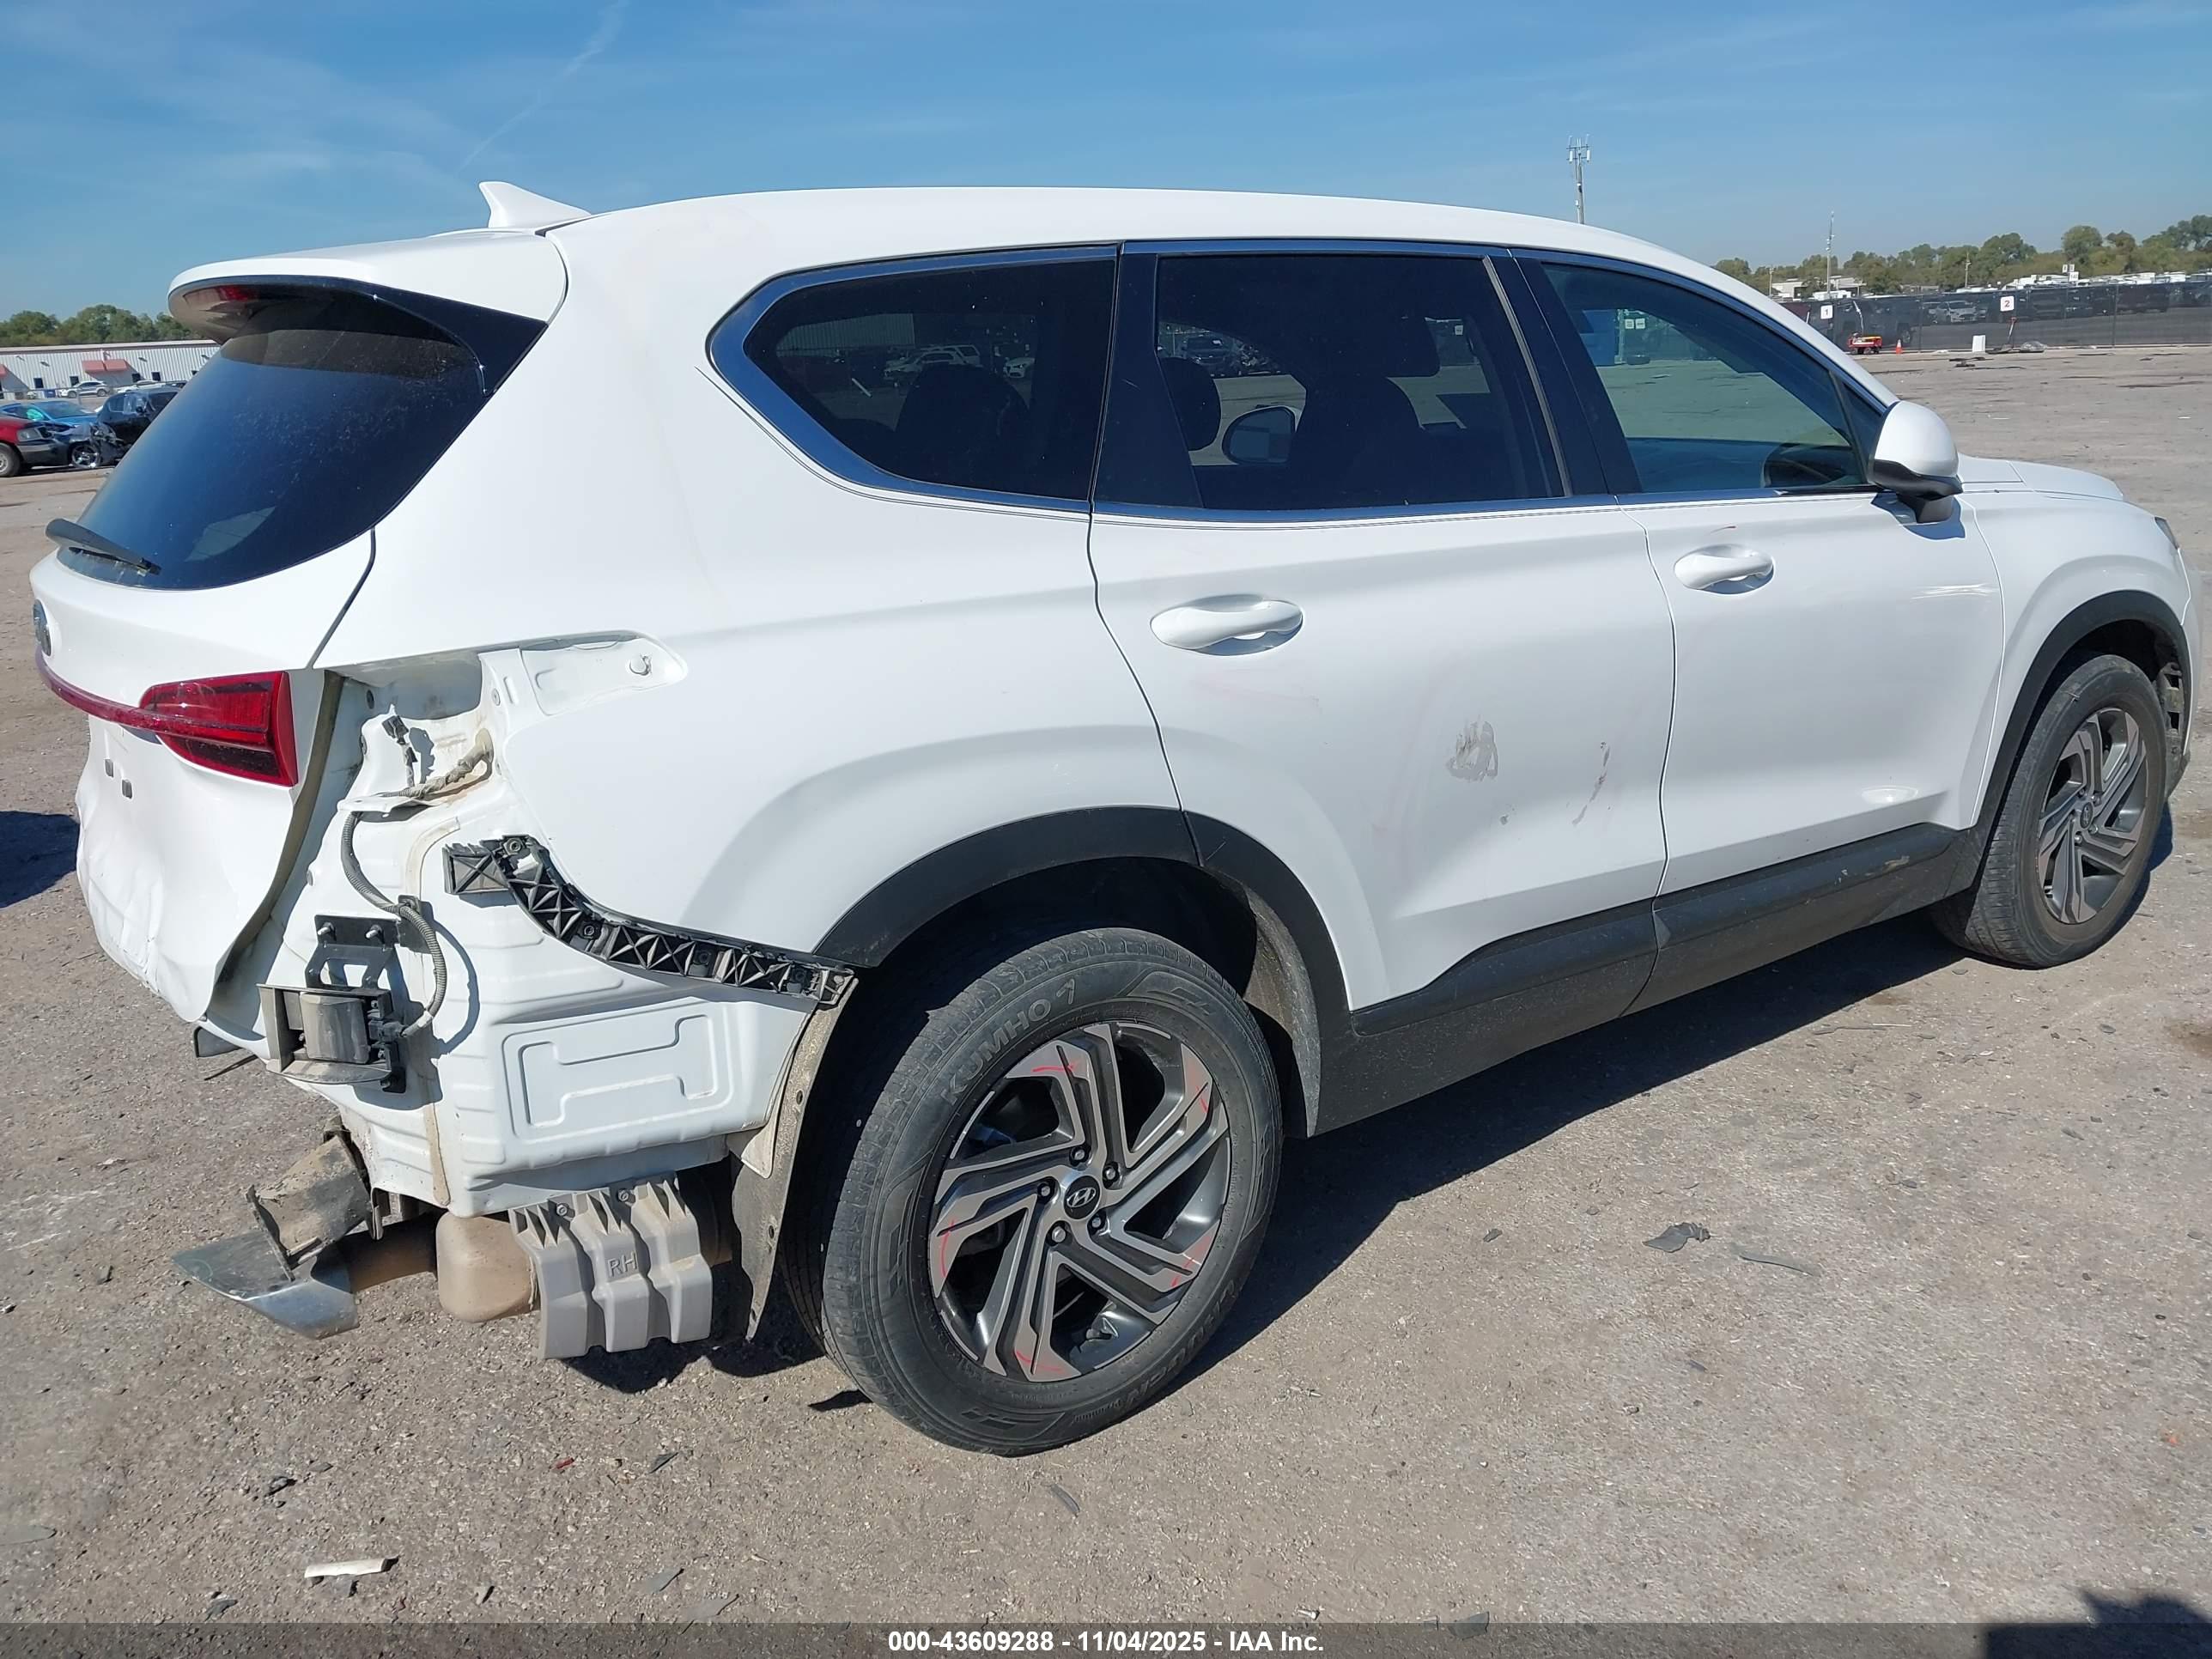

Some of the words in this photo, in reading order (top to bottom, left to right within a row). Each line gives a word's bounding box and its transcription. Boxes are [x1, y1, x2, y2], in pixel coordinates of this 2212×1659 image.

[2004, 300, 2011, 308] 2
[940, 999, 1051, 1106] KUMHO
[607, 1251, 638, 1278] RH
